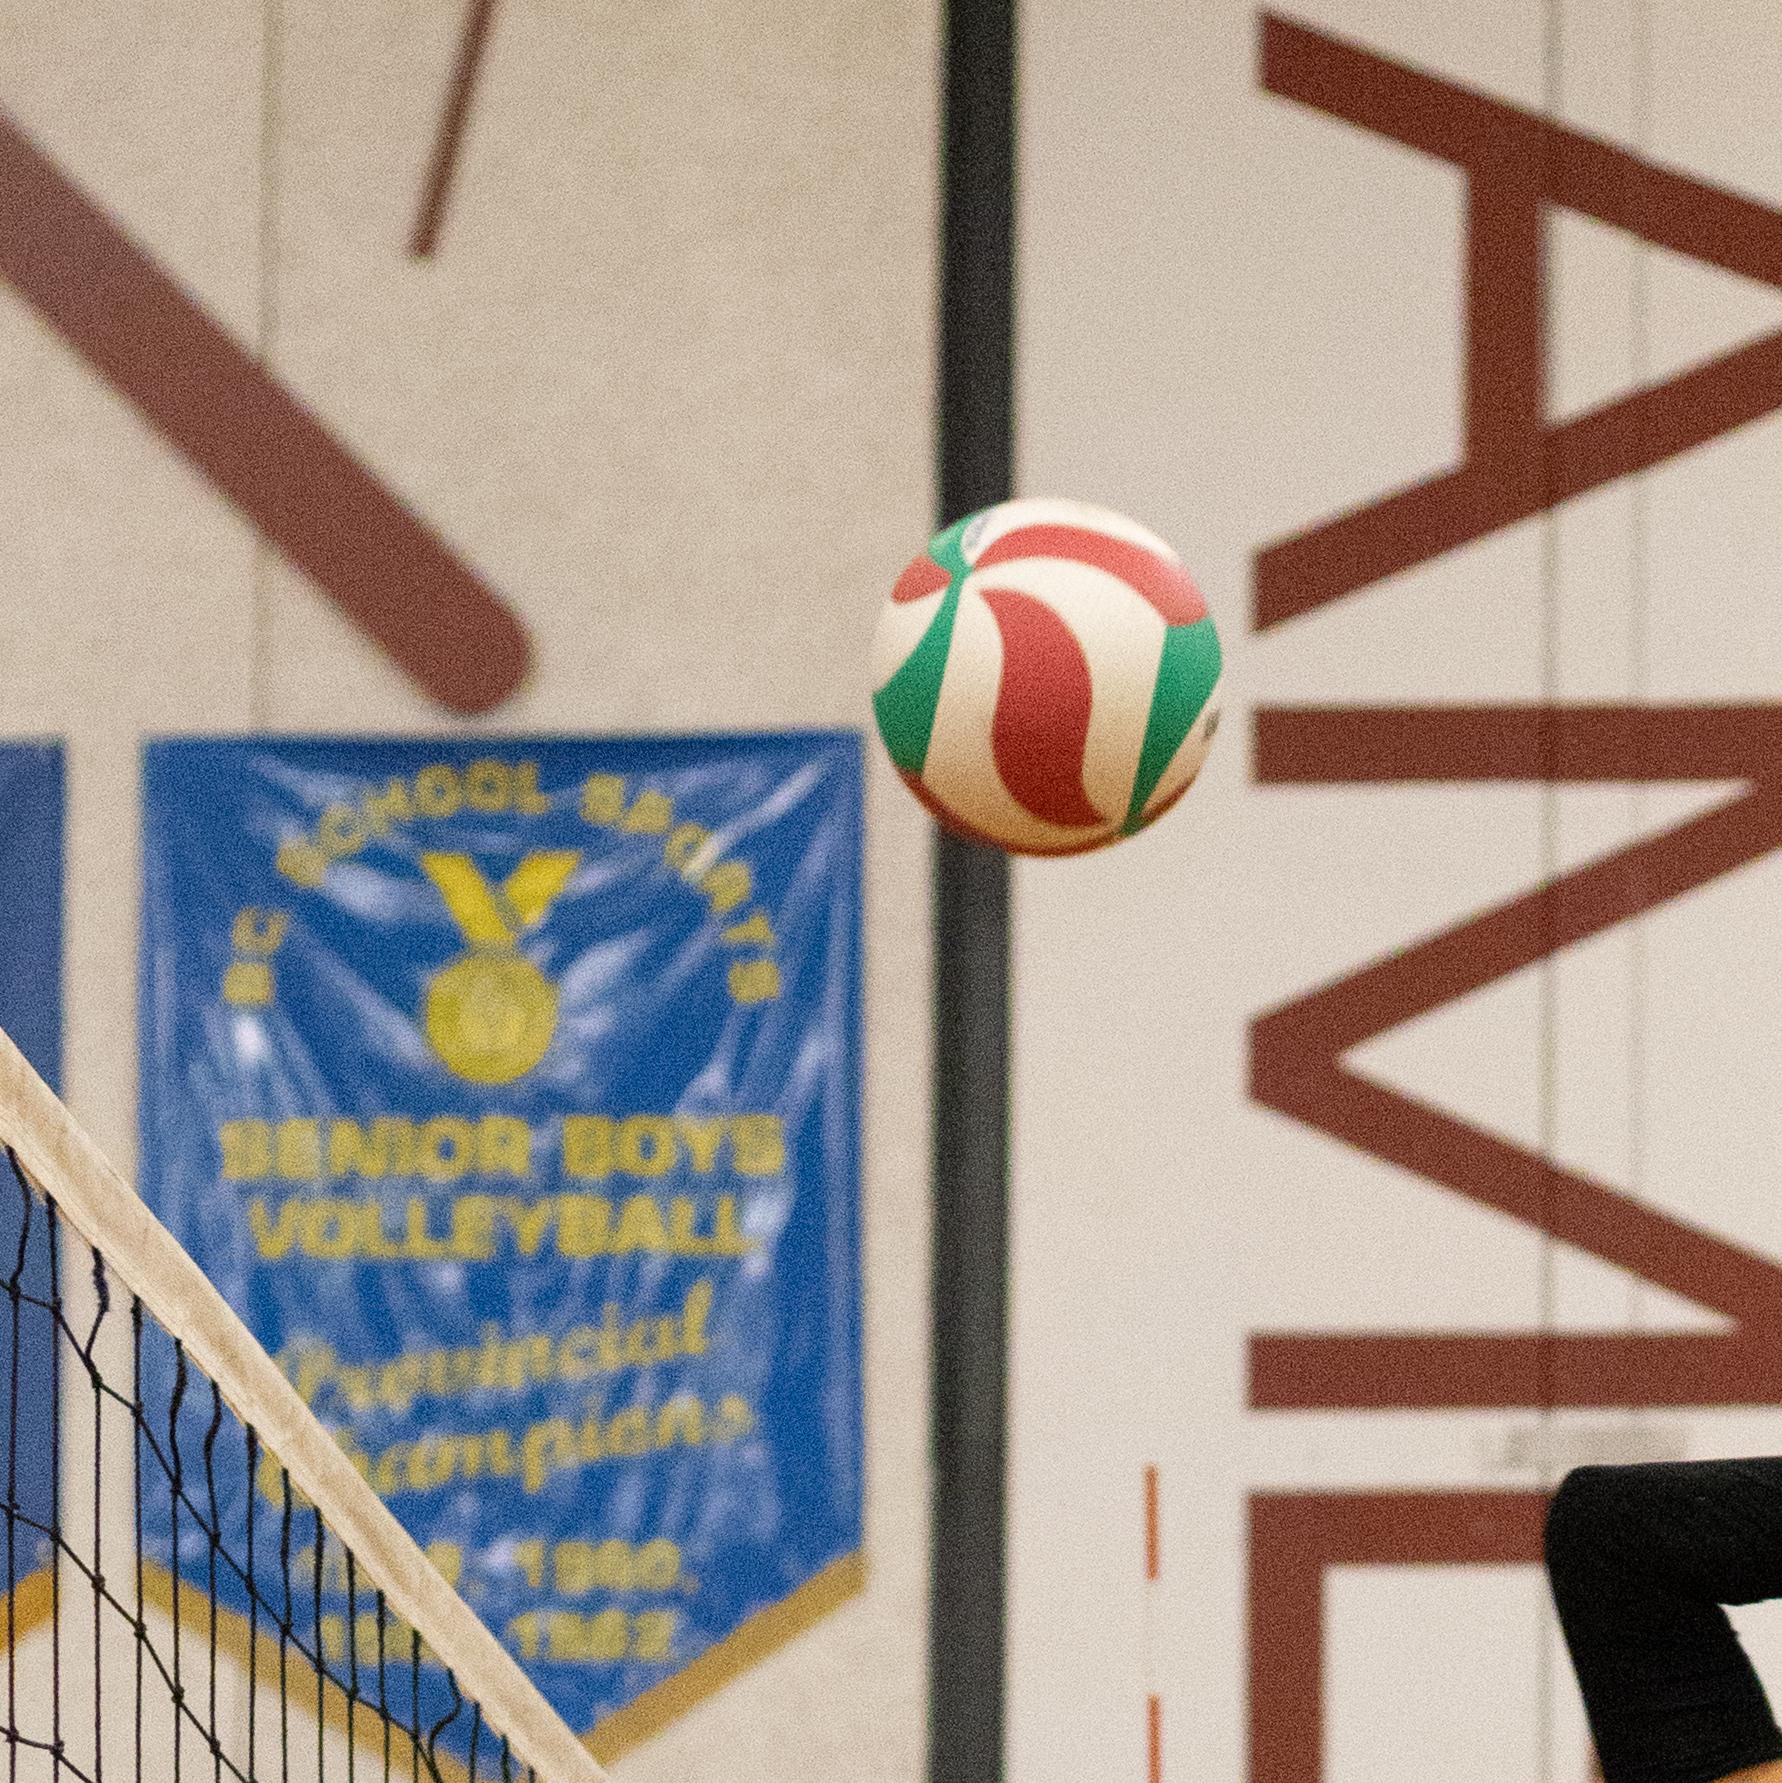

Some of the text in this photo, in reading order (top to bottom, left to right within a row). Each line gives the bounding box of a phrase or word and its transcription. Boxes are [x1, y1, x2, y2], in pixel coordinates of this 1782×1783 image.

[275, 758, 549, 889] SCHOOL
[218, 1113, 787, 1181] SENIOR BOYS
[247, 1193, 764, 1260] VOLLEYBALL
[271, 1278, 714, 1411] Provincial
